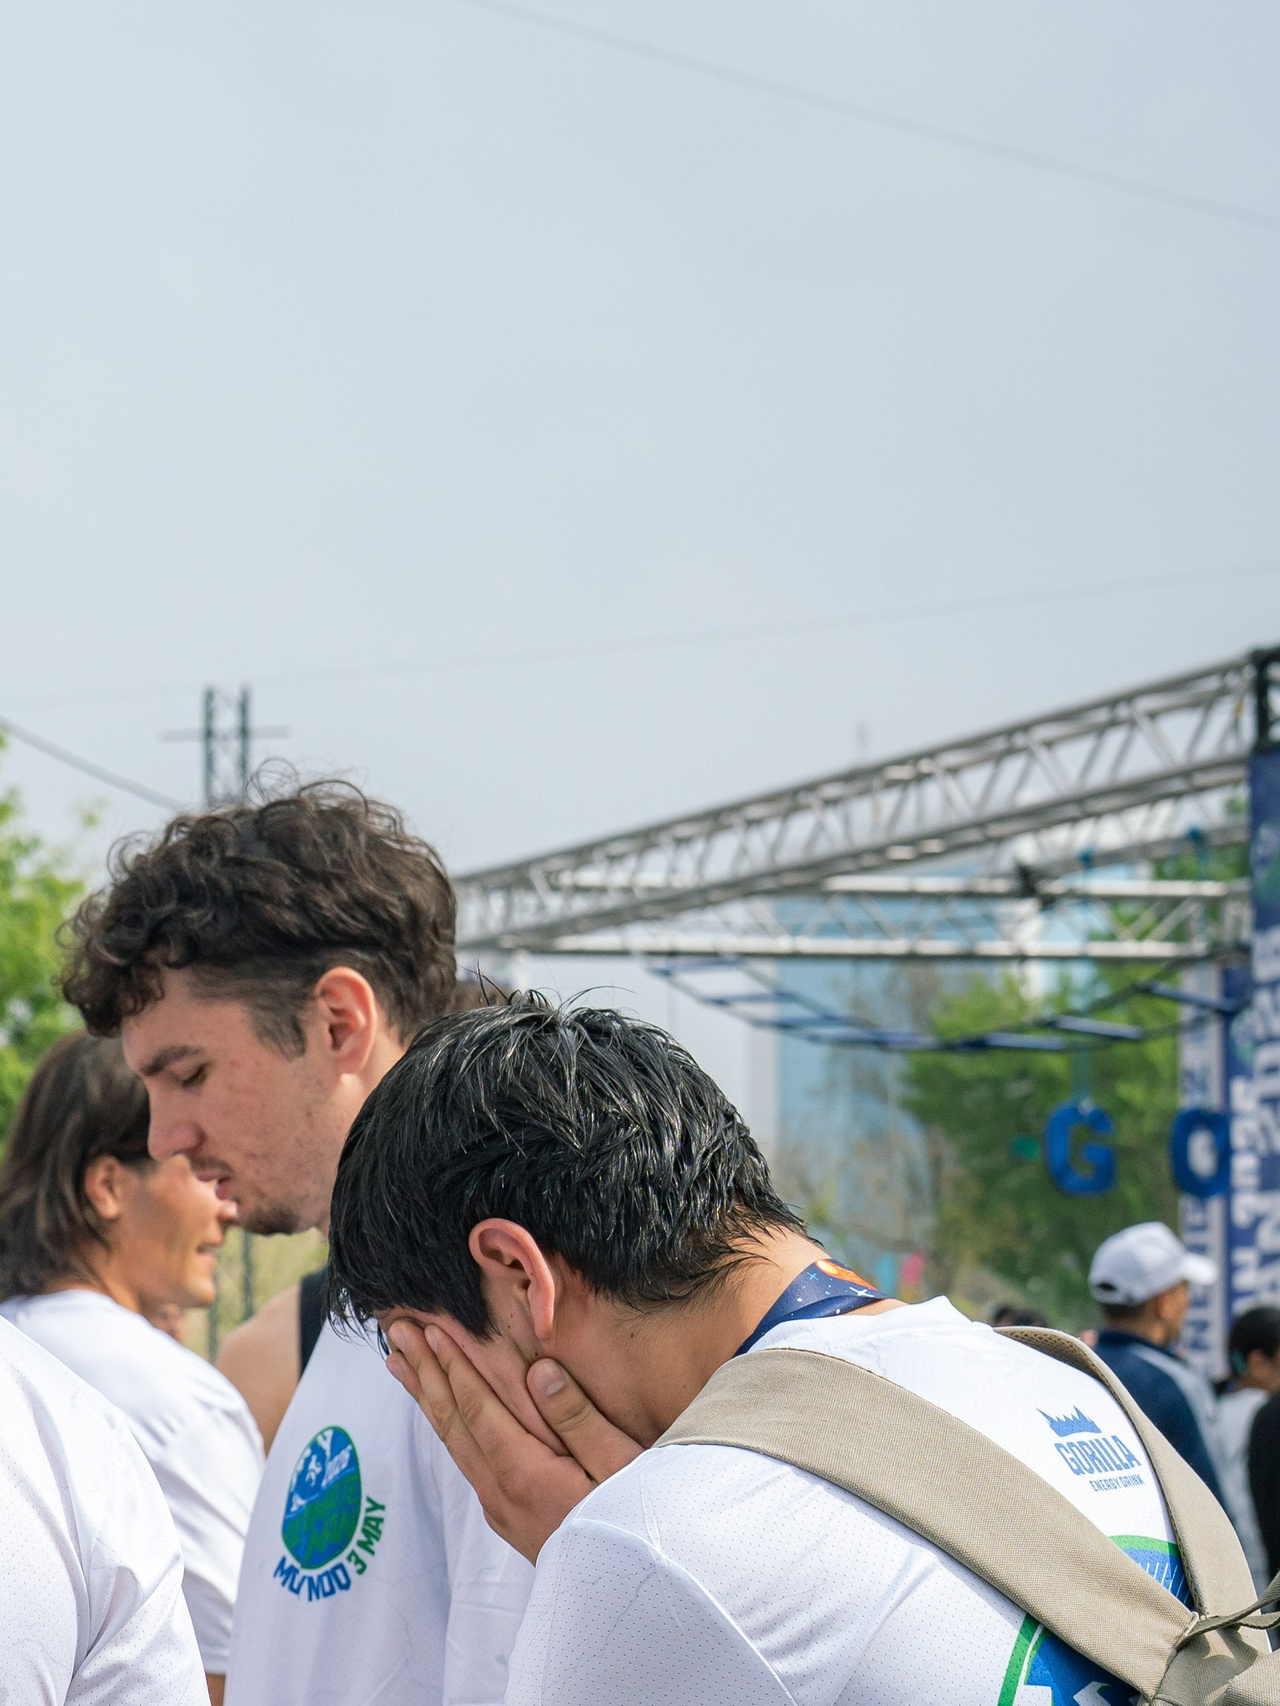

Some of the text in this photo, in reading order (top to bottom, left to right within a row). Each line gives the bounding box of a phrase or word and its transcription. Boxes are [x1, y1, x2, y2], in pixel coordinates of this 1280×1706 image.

[1053, 1434, 1142, 1476] GORILLA
[1089, 1474, 1145, 1492] ENERGY DRINK
[346, 1496, 386, 1575] 3 MAY
